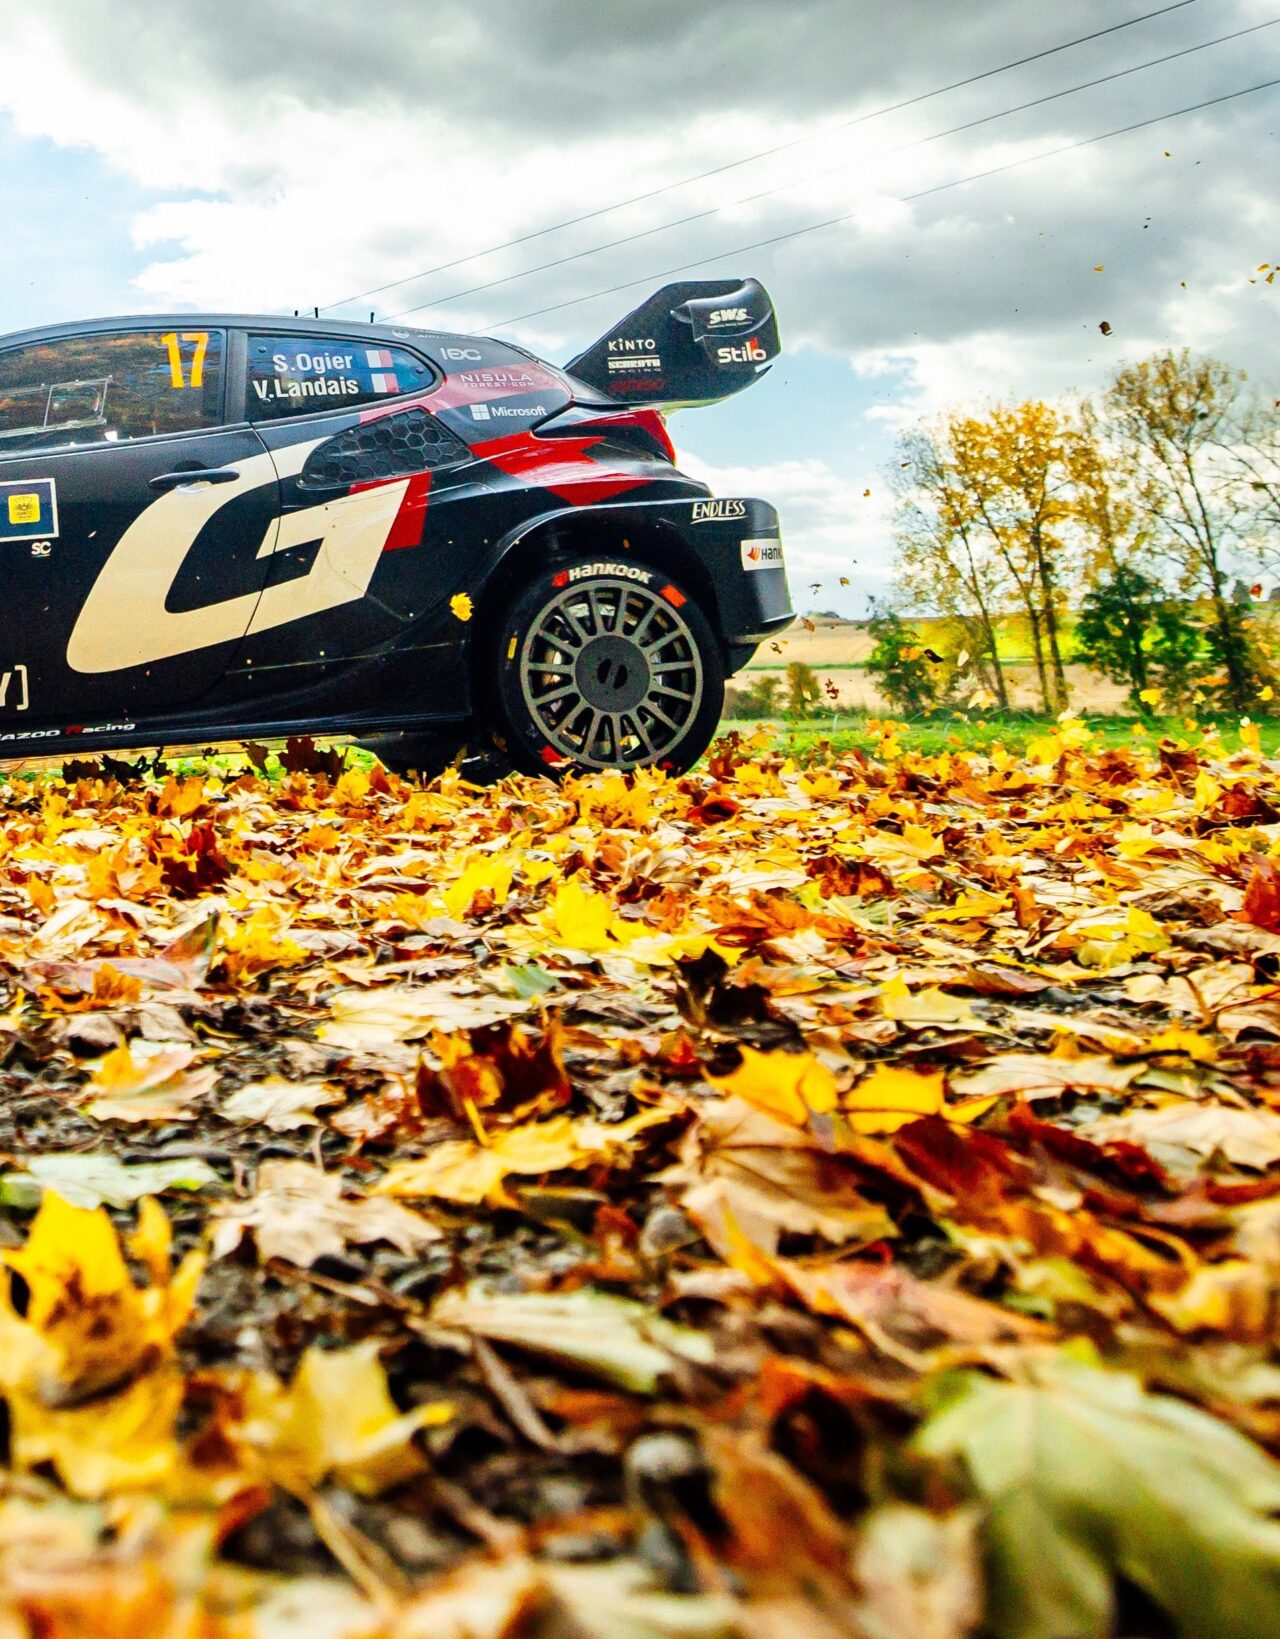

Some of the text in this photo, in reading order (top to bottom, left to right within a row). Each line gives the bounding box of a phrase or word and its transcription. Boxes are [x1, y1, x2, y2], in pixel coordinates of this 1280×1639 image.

[709, 308, 753, 325] SWS
[718, 337, 767, 364] Stilo
[161, 332, 209, 389] 17
[272, 353, 353, 374] S.Ogier
[460, 373, 533, 383] NISULA
[253, 376, 360, 399] V.Landais
[491, 405, 548, 418] Microsoft
[692, 501, 746, 519] ENDLESS
[31, 541, 52, 556] SC
[65, 723, 136, 735] Racing
